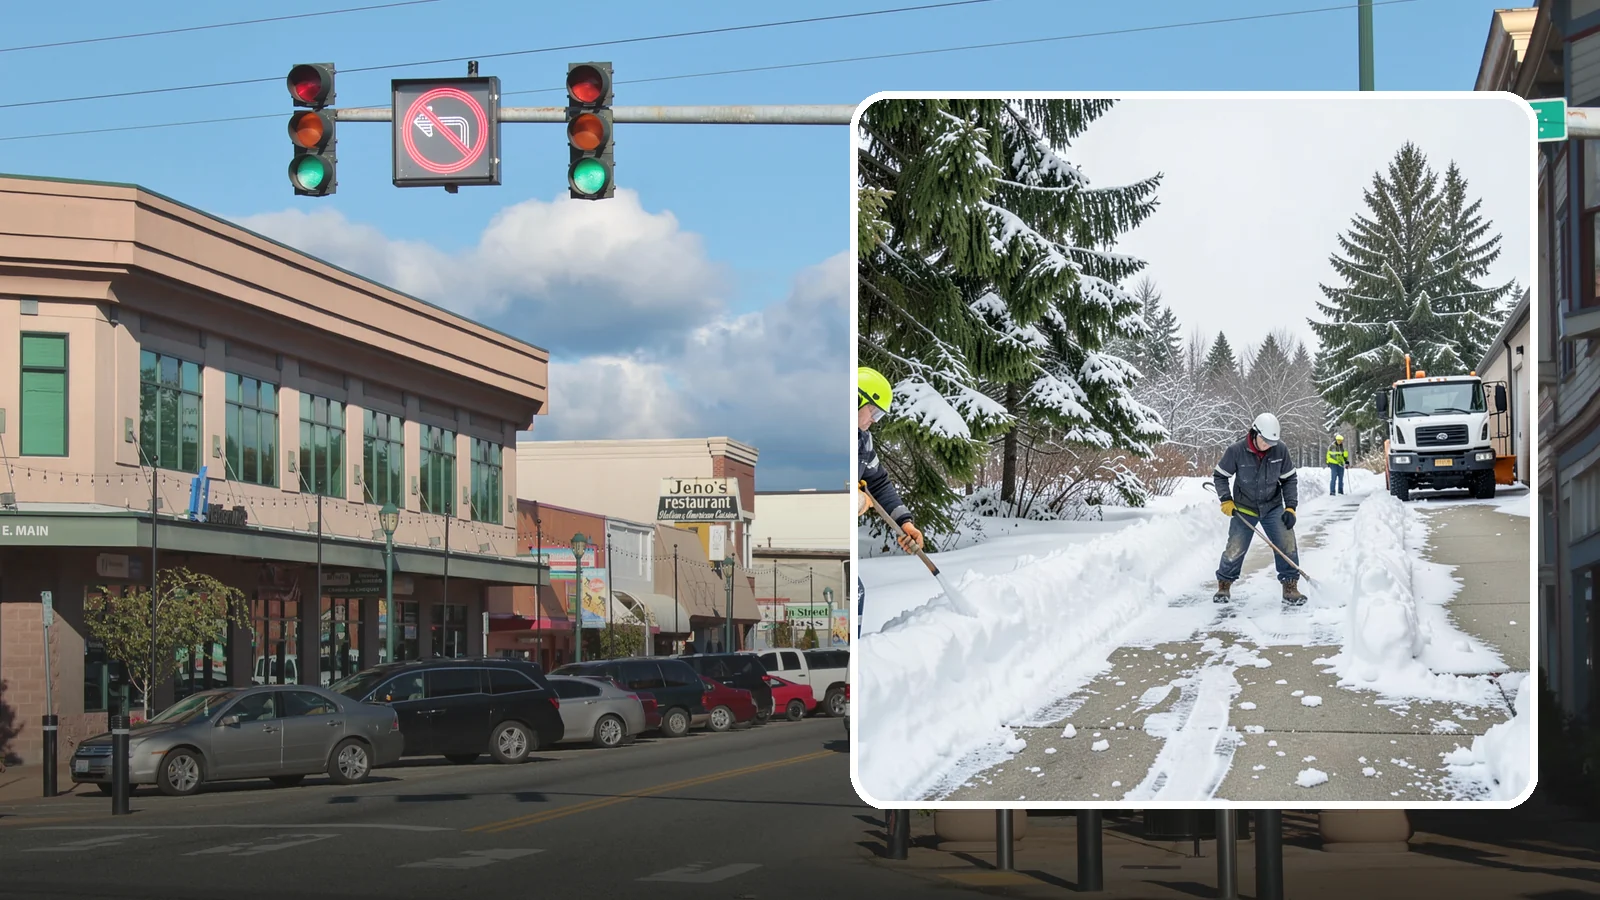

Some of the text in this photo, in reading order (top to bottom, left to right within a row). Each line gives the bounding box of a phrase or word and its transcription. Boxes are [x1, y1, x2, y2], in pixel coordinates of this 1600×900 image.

[670, 480, 727, 494] Jeno's
[665, 496, 731, 509] restaurant
[659, 510, 681, 519] Italian
[686, 510, 715, 519] American
[715, 510, 737, 519] Cuisine
[2, 525, 49, 536] E. MAIN
[797, 607, 828, 616] Street
